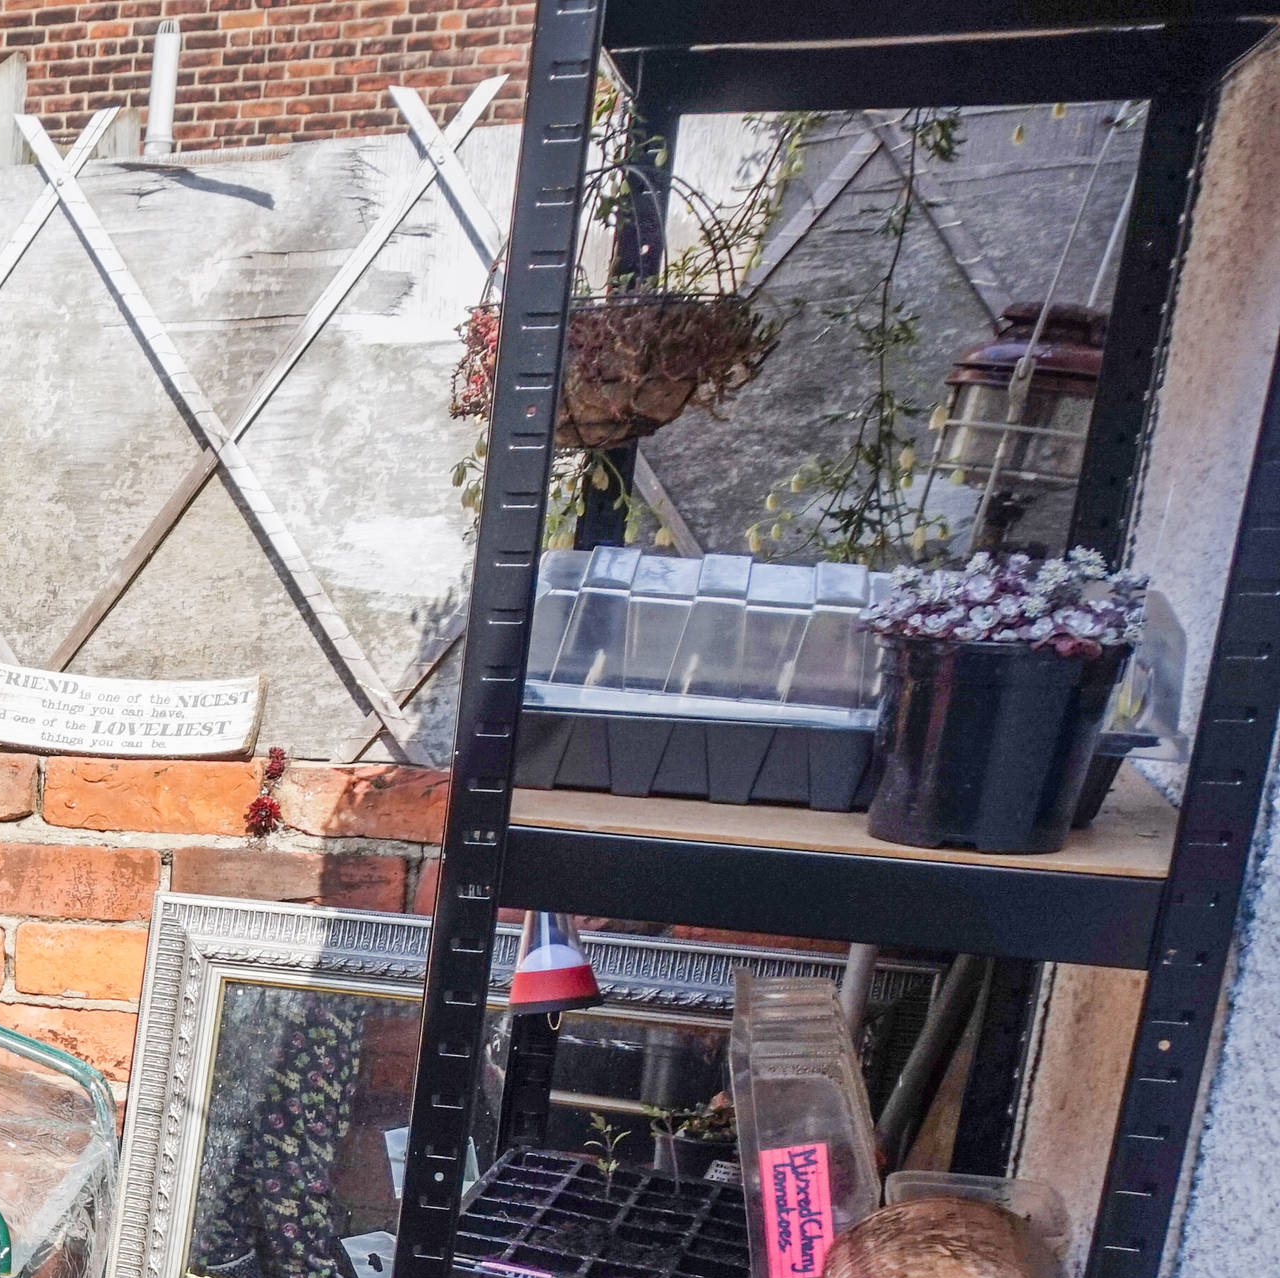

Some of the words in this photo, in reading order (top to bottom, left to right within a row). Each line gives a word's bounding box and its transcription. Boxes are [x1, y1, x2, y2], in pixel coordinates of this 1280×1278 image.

[41, 698, 85, 715] things
[90, 704, 115, 717] you
[121, 708, 144, 717] can
[151, 707, 185, 719] have,
[79, 690, 92, 700] is
[97, 691, 121, 703] one
[127, 693, 143, 704] of
[150, 693, 171, 705] the
[175, 690, 254, 708] NICEST
[13, 714, 36, 725] one
[42, 717, 58, 728] of
[65, 719, 87, 731] the
[91, 720, 233, 737] LOVELIEST
[40, 731, 84, 746] things
[89, 737, 114, 748] you
[121, 740, 143, 748] can
[789, 1149, 823, 1218] Mixed
[791, 1218, 824, 1273] Cherry
